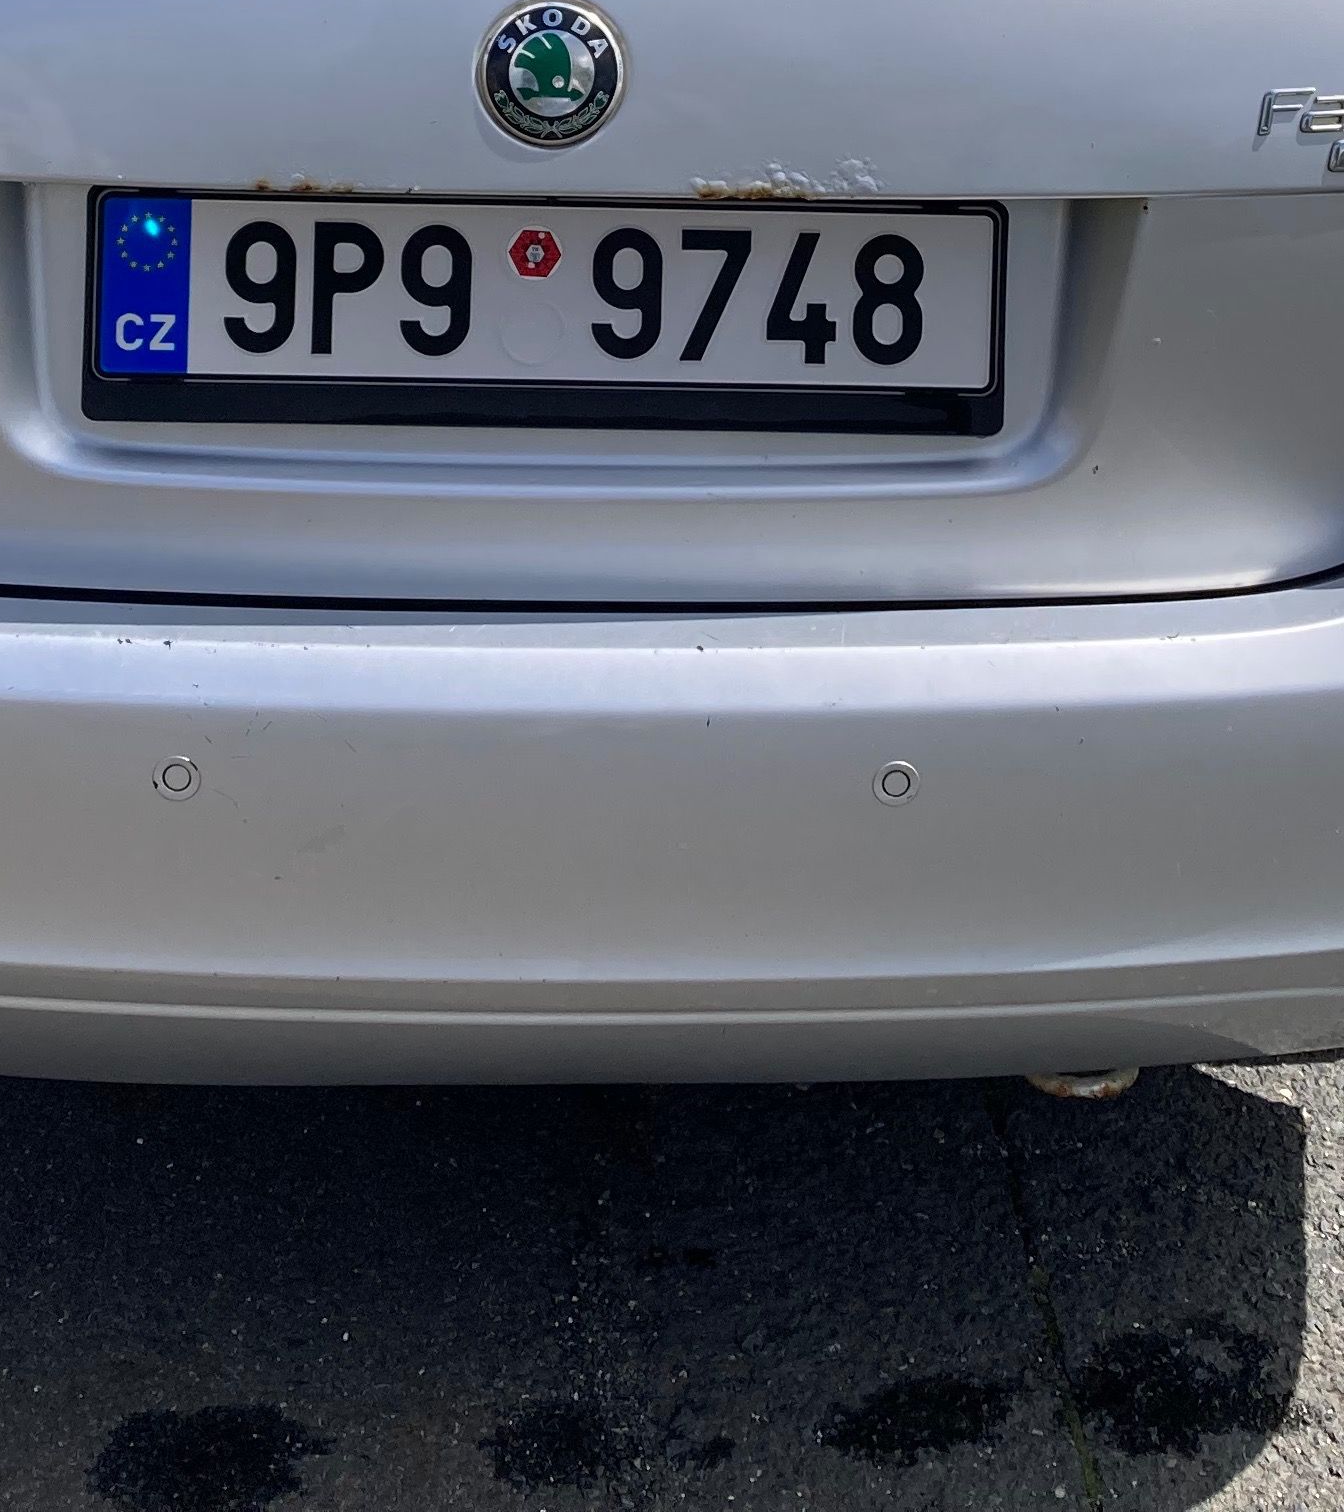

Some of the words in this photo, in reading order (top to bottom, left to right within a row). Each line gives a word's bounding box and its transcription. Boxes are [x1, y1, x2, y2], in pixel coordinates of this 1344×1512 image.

[115, 312, 176, 351] CZ
[224, 221, 472, 357] 9P9
[591, 227, 924, 366] 9748
